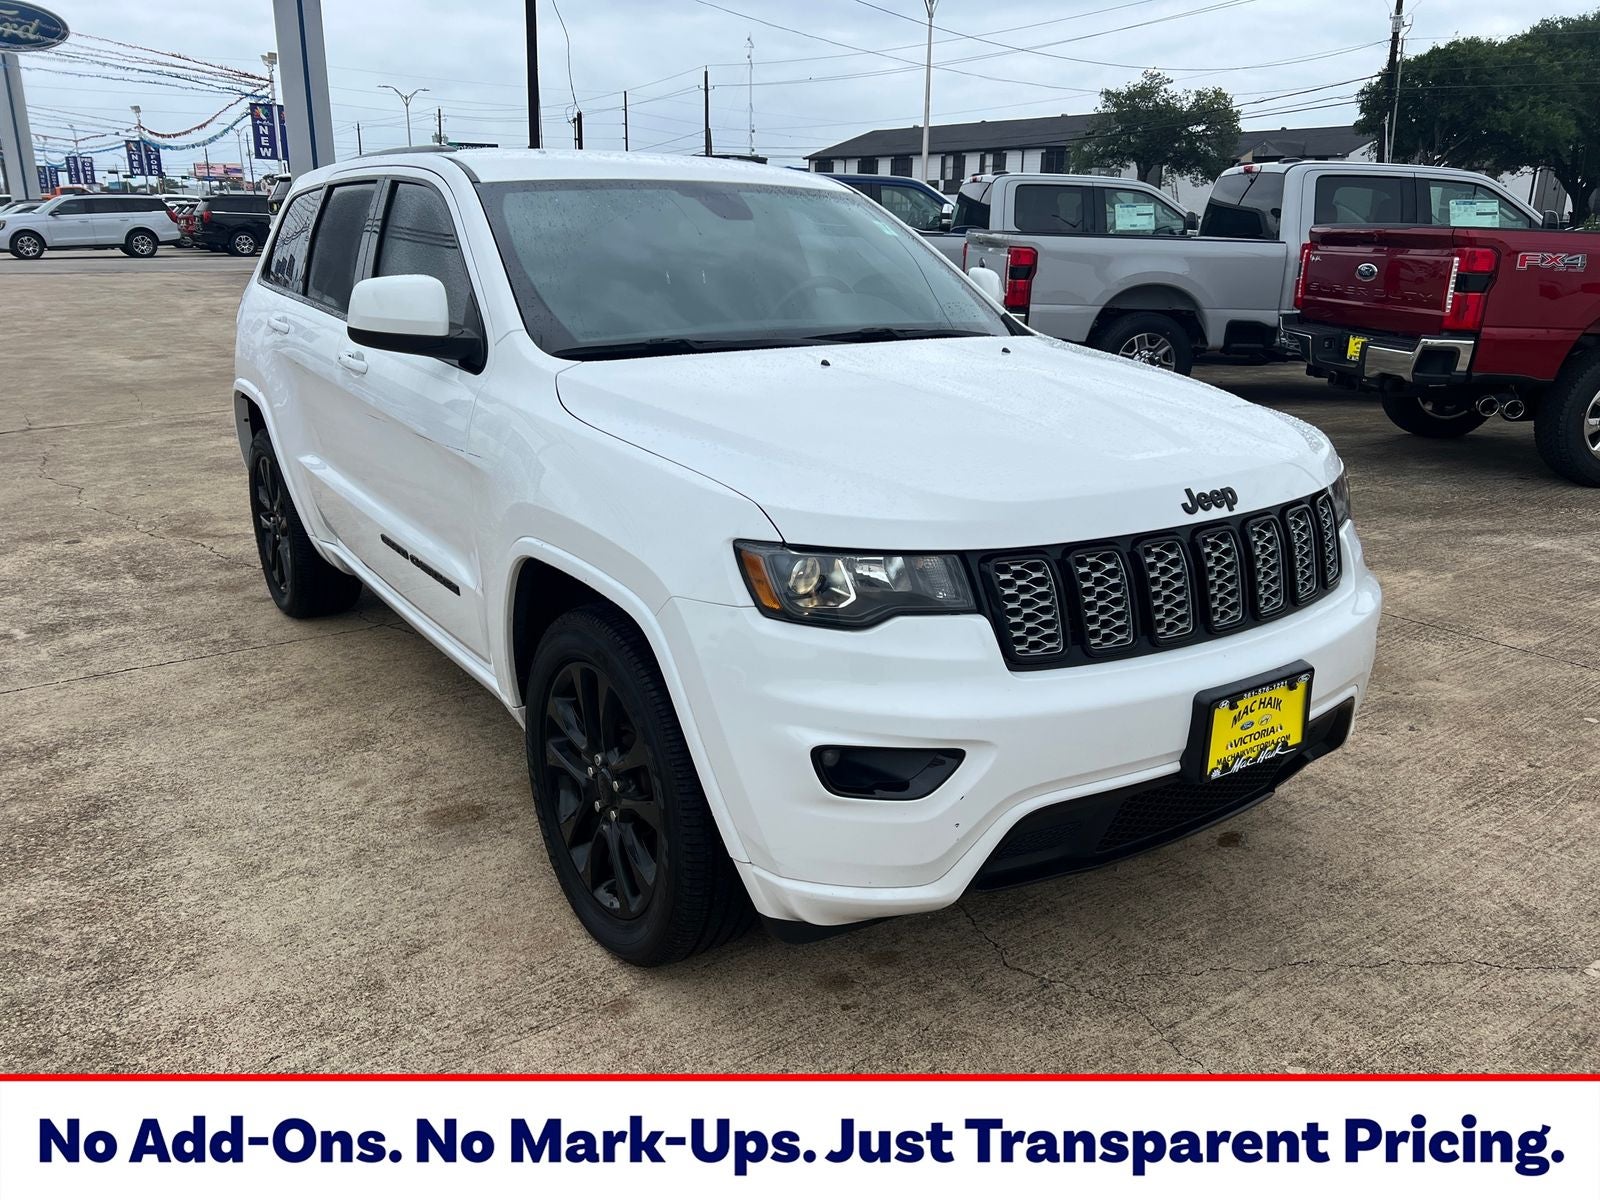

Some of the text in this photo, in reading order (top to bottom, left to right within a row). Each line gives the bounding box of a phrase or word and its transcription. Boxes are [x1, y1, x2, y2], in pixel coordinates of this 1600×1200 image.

[259, 125, 272, 157] NEW
[131, 154, 141, 175] NEW
[150, 154, 158, 175] FORD
[1516, 252, 1587, 271] FX4
[1309, 282, 1433, 302] SUPER DUTY
[1181, 486, 1239, 515] Jeep
[1231, 696, 1283, 728] MAC HAIK
[1233, 726, 1276, 749] VICTORIA
[1230, 744, 1288, 773] Mac Haik
